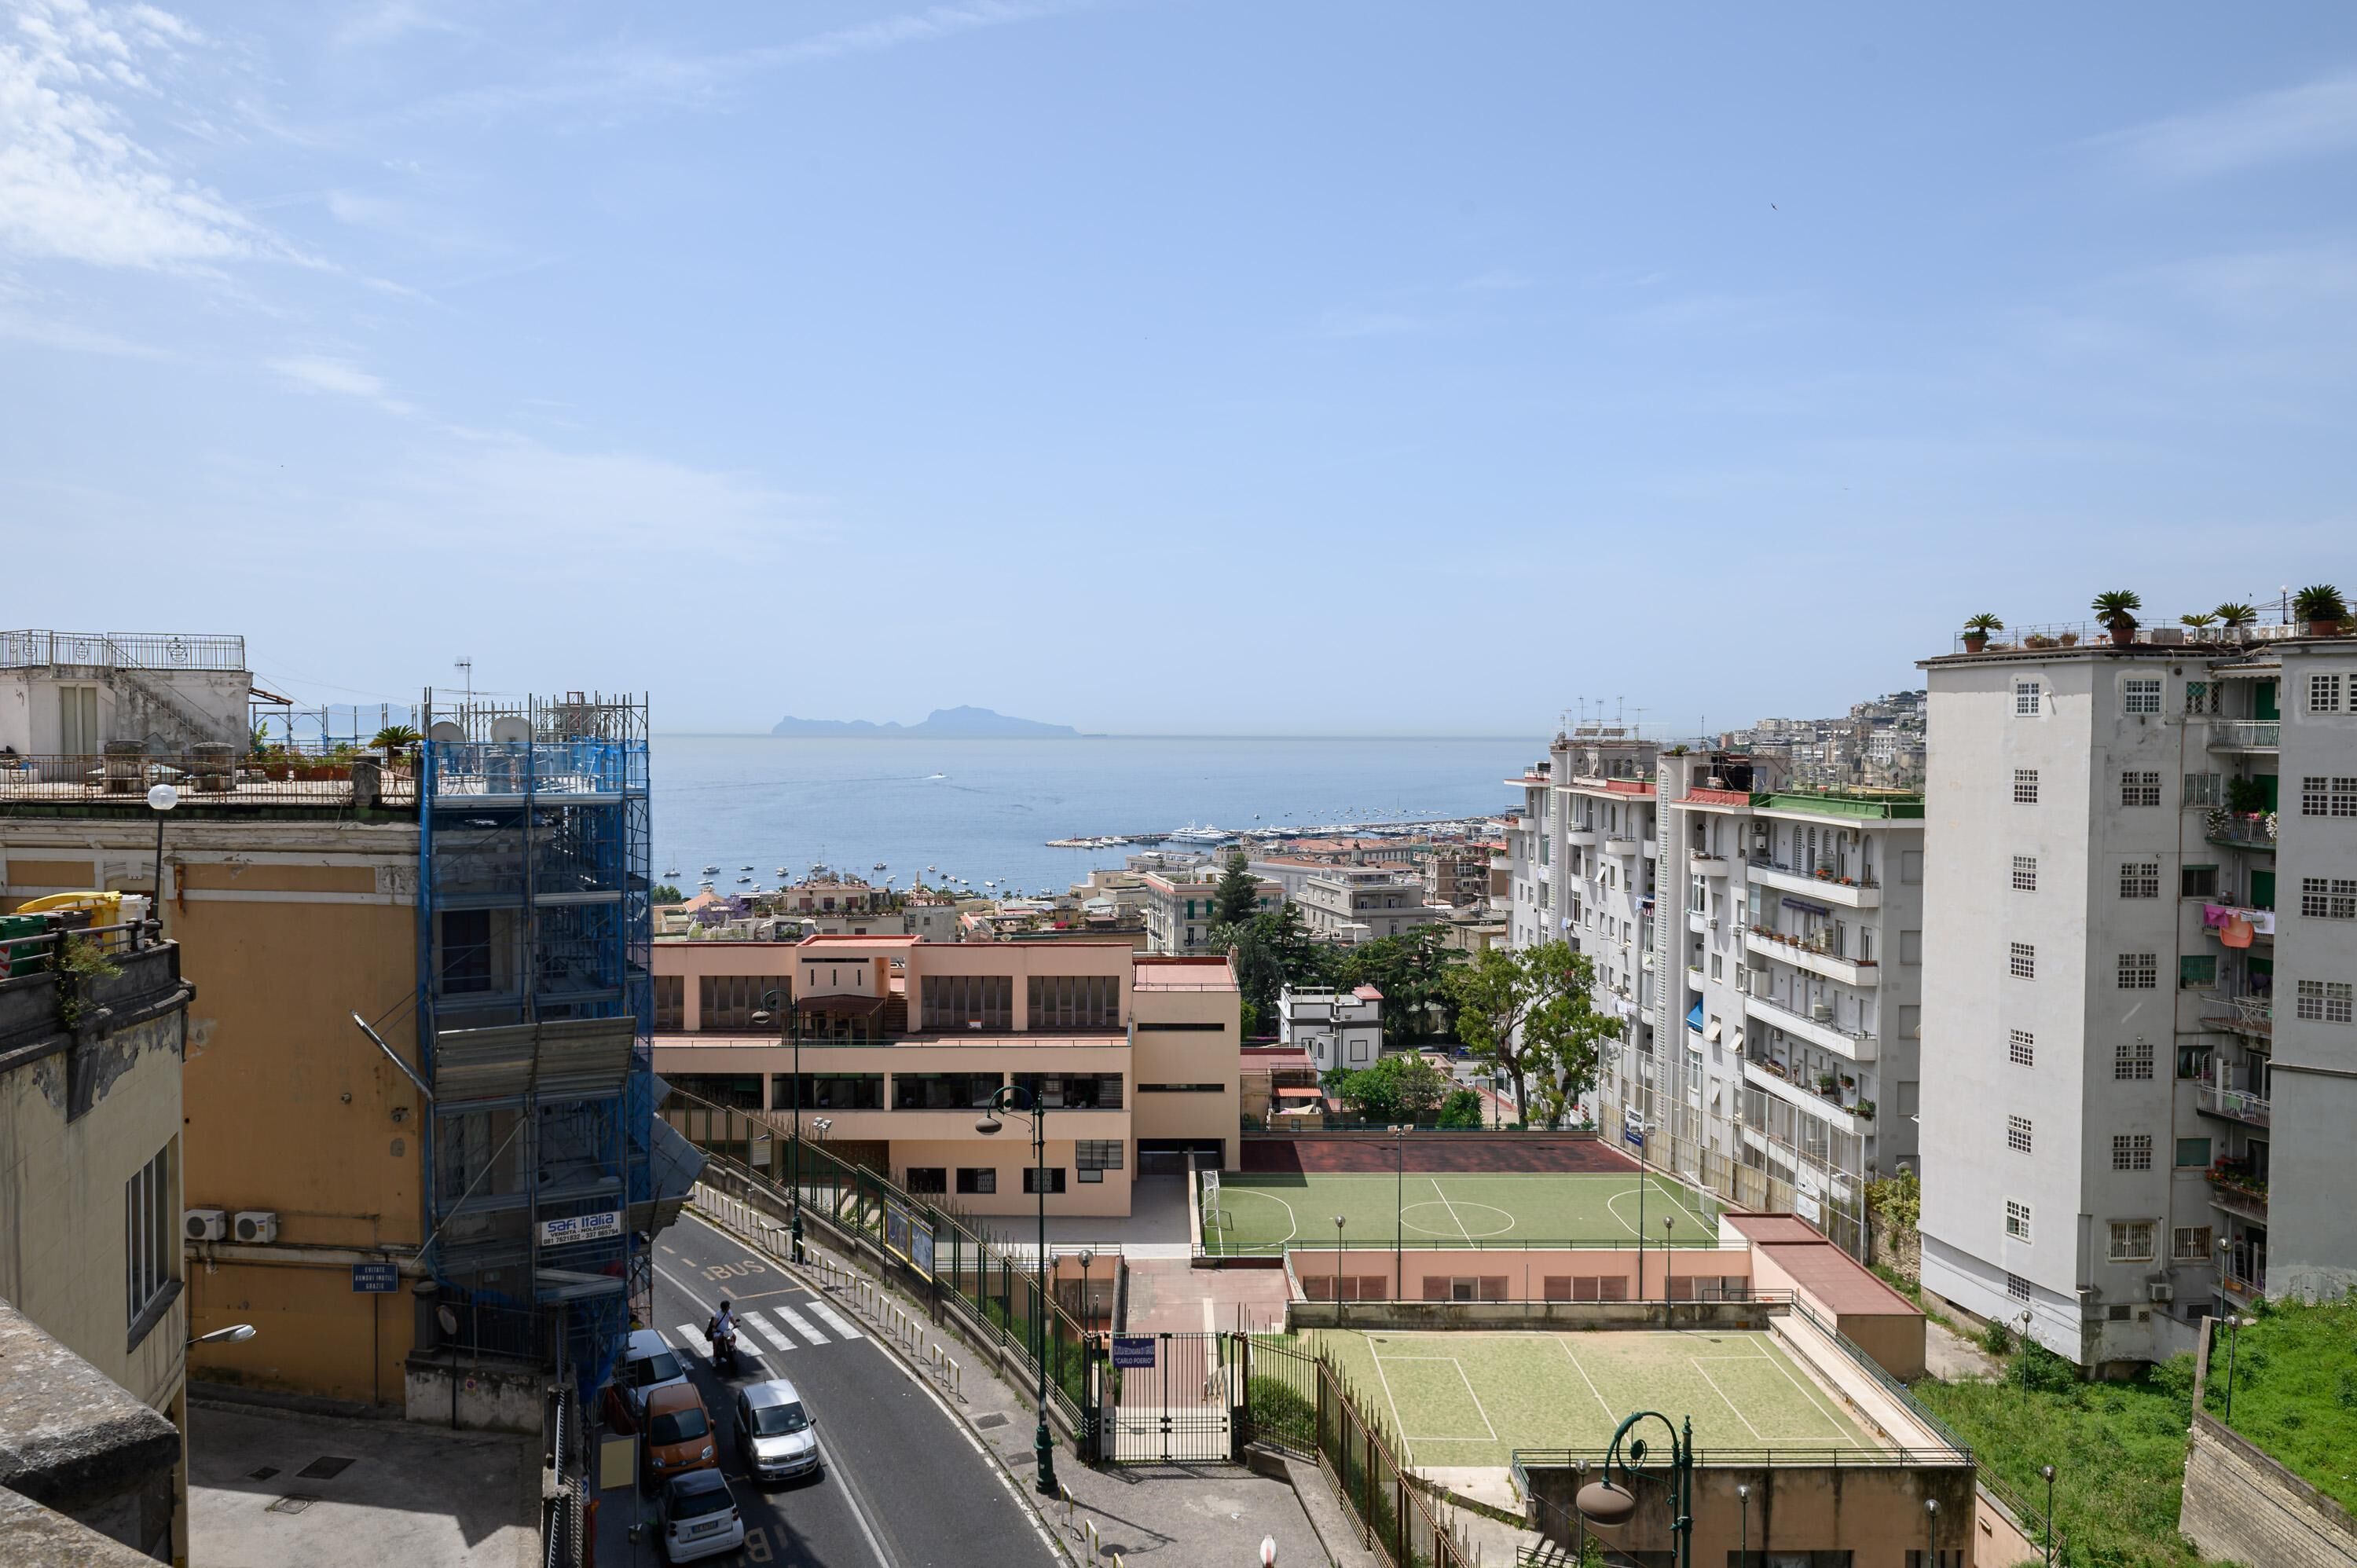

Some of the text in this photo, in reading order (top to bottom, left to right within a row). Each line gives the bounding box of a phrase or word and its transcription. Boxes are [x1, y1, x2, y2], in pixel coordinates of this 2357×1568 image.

[581, 1214, 614, 1228] Italia
[581, 1224, 612, 1233] NOLEGGIO
[706, 1260, 766, 1279] BUS
[1113, 1346, 1124, 1355] SCUOLA
